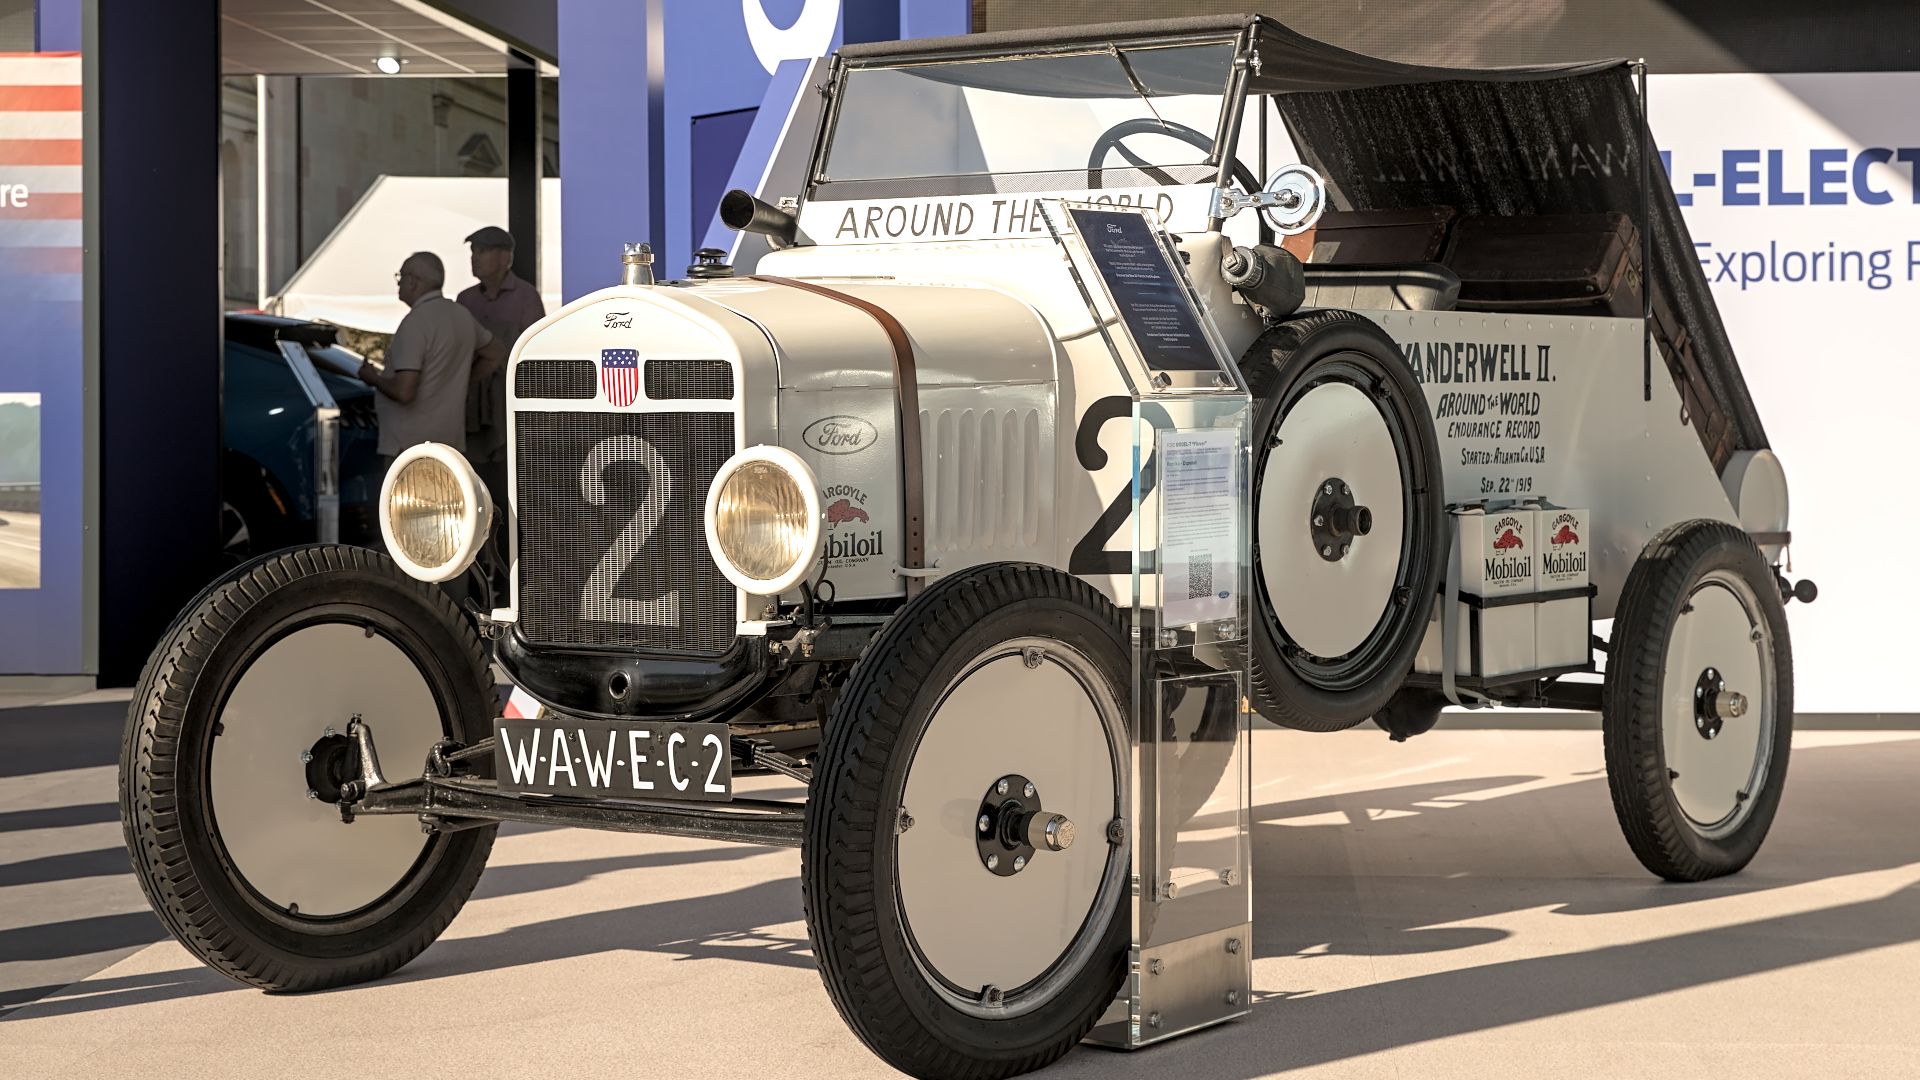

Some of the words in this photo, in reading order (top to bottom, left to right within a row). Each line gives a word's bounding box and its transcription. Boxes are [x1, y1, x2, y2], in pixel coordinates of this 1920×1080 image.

[0, 184, 29, 208] re
[835, 202, 974, 239] AROUND
[992, 198, 1042, 234] THE
[604, 311, 633, 328] Ford
[1436, 392, 1486, 420] AROUND
[1499, 392, 1541, 417] WORLD
[818, 422, 863, 447] Ford
[1448, 420, 1502, 439] ENDURANCE
[1505, 420, 1541, 439] RECORD
[1069, 396, 1176, 575] 2
[1515, 476, 1532, 492] 1919
[579, 434, 680, 627] 2
[1494, 516, 1523, 535] GARGOYLE
[1551, 513, 1580, 530] GARGOYLE
[820, 530, 883, 560] biloil
[1485, 556, 1531, 580] Mobiloil
[1542, 551, 1586, 575] Mobiloil
